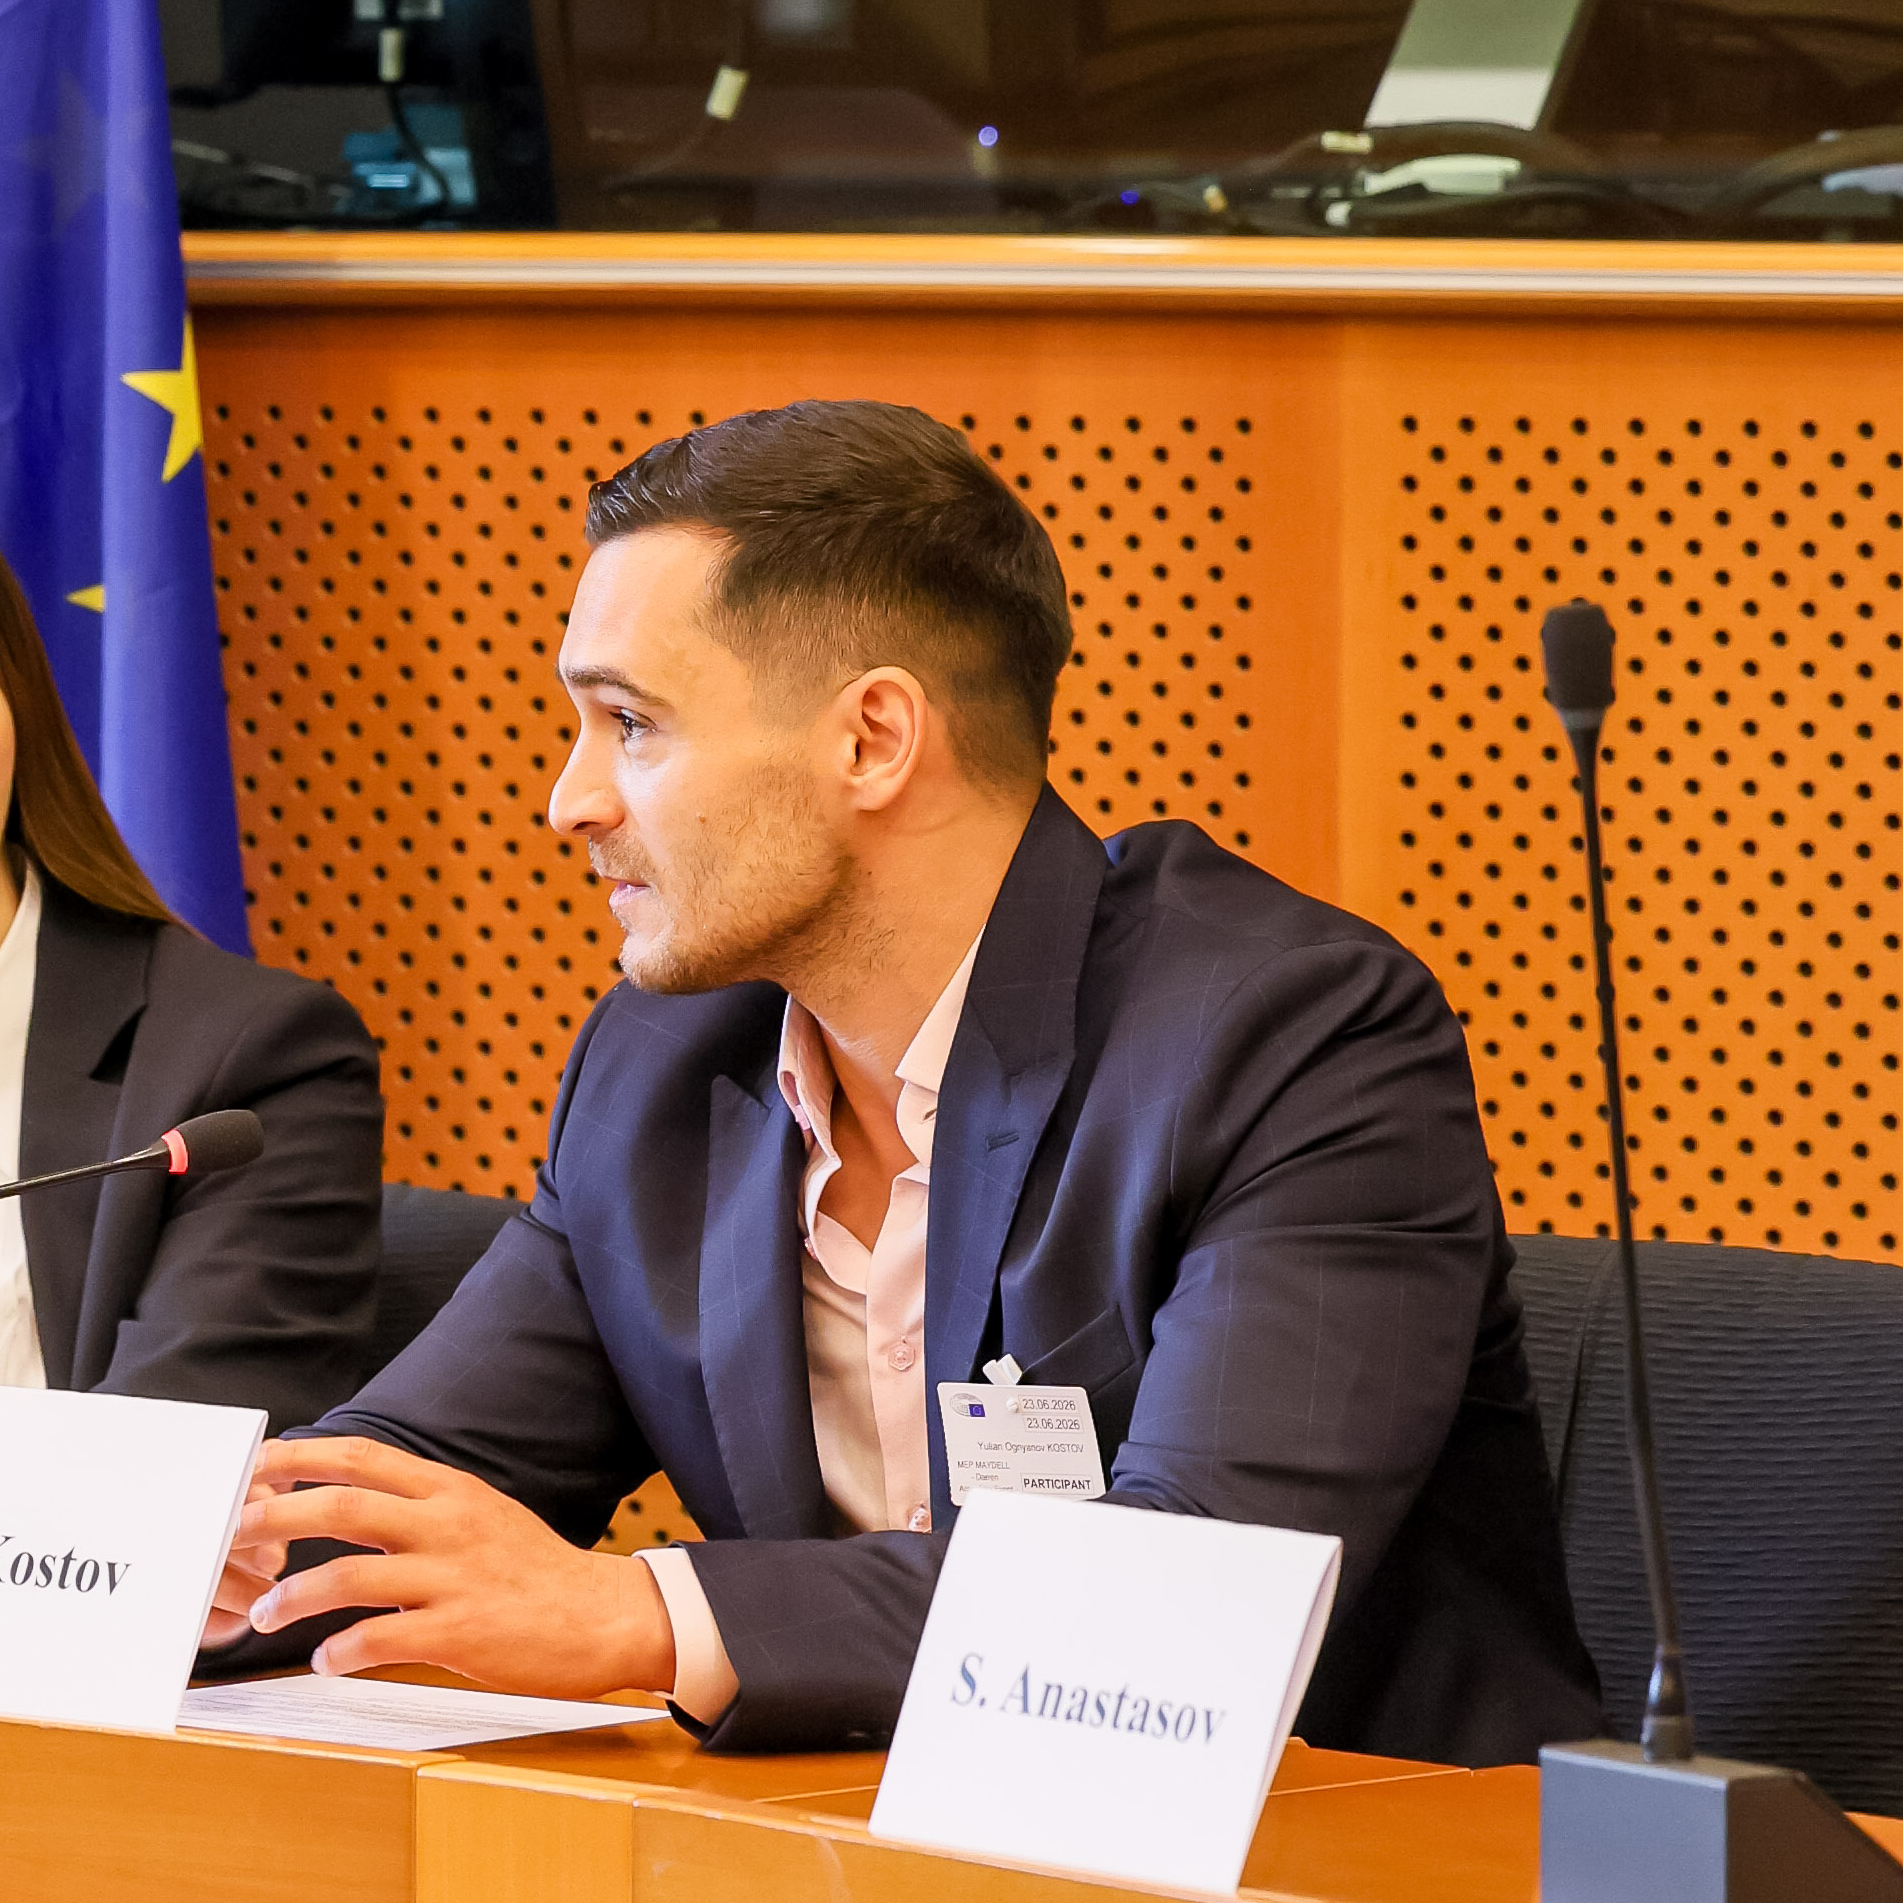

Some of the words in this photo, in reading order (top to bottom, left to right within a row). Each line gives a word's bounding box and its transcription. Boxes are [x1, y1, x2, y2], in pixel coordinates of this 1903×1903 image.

[1022, 1398, 1077, 1411] 23.06.2026
[1027, 1417, 1081, 1430] 23.06.2026
[1046, 1442, 1084, 1453] KOSTOV
[957, 1460, 974, 1469] MEP
[975, 1460, 1011, 1469] MAYDELL
[1023, 1478, 1092, 1490] PARTICIPANT
[950, 1652, 987, 1708] S.
[998, 1662, 1228, 1746] Anastasov
